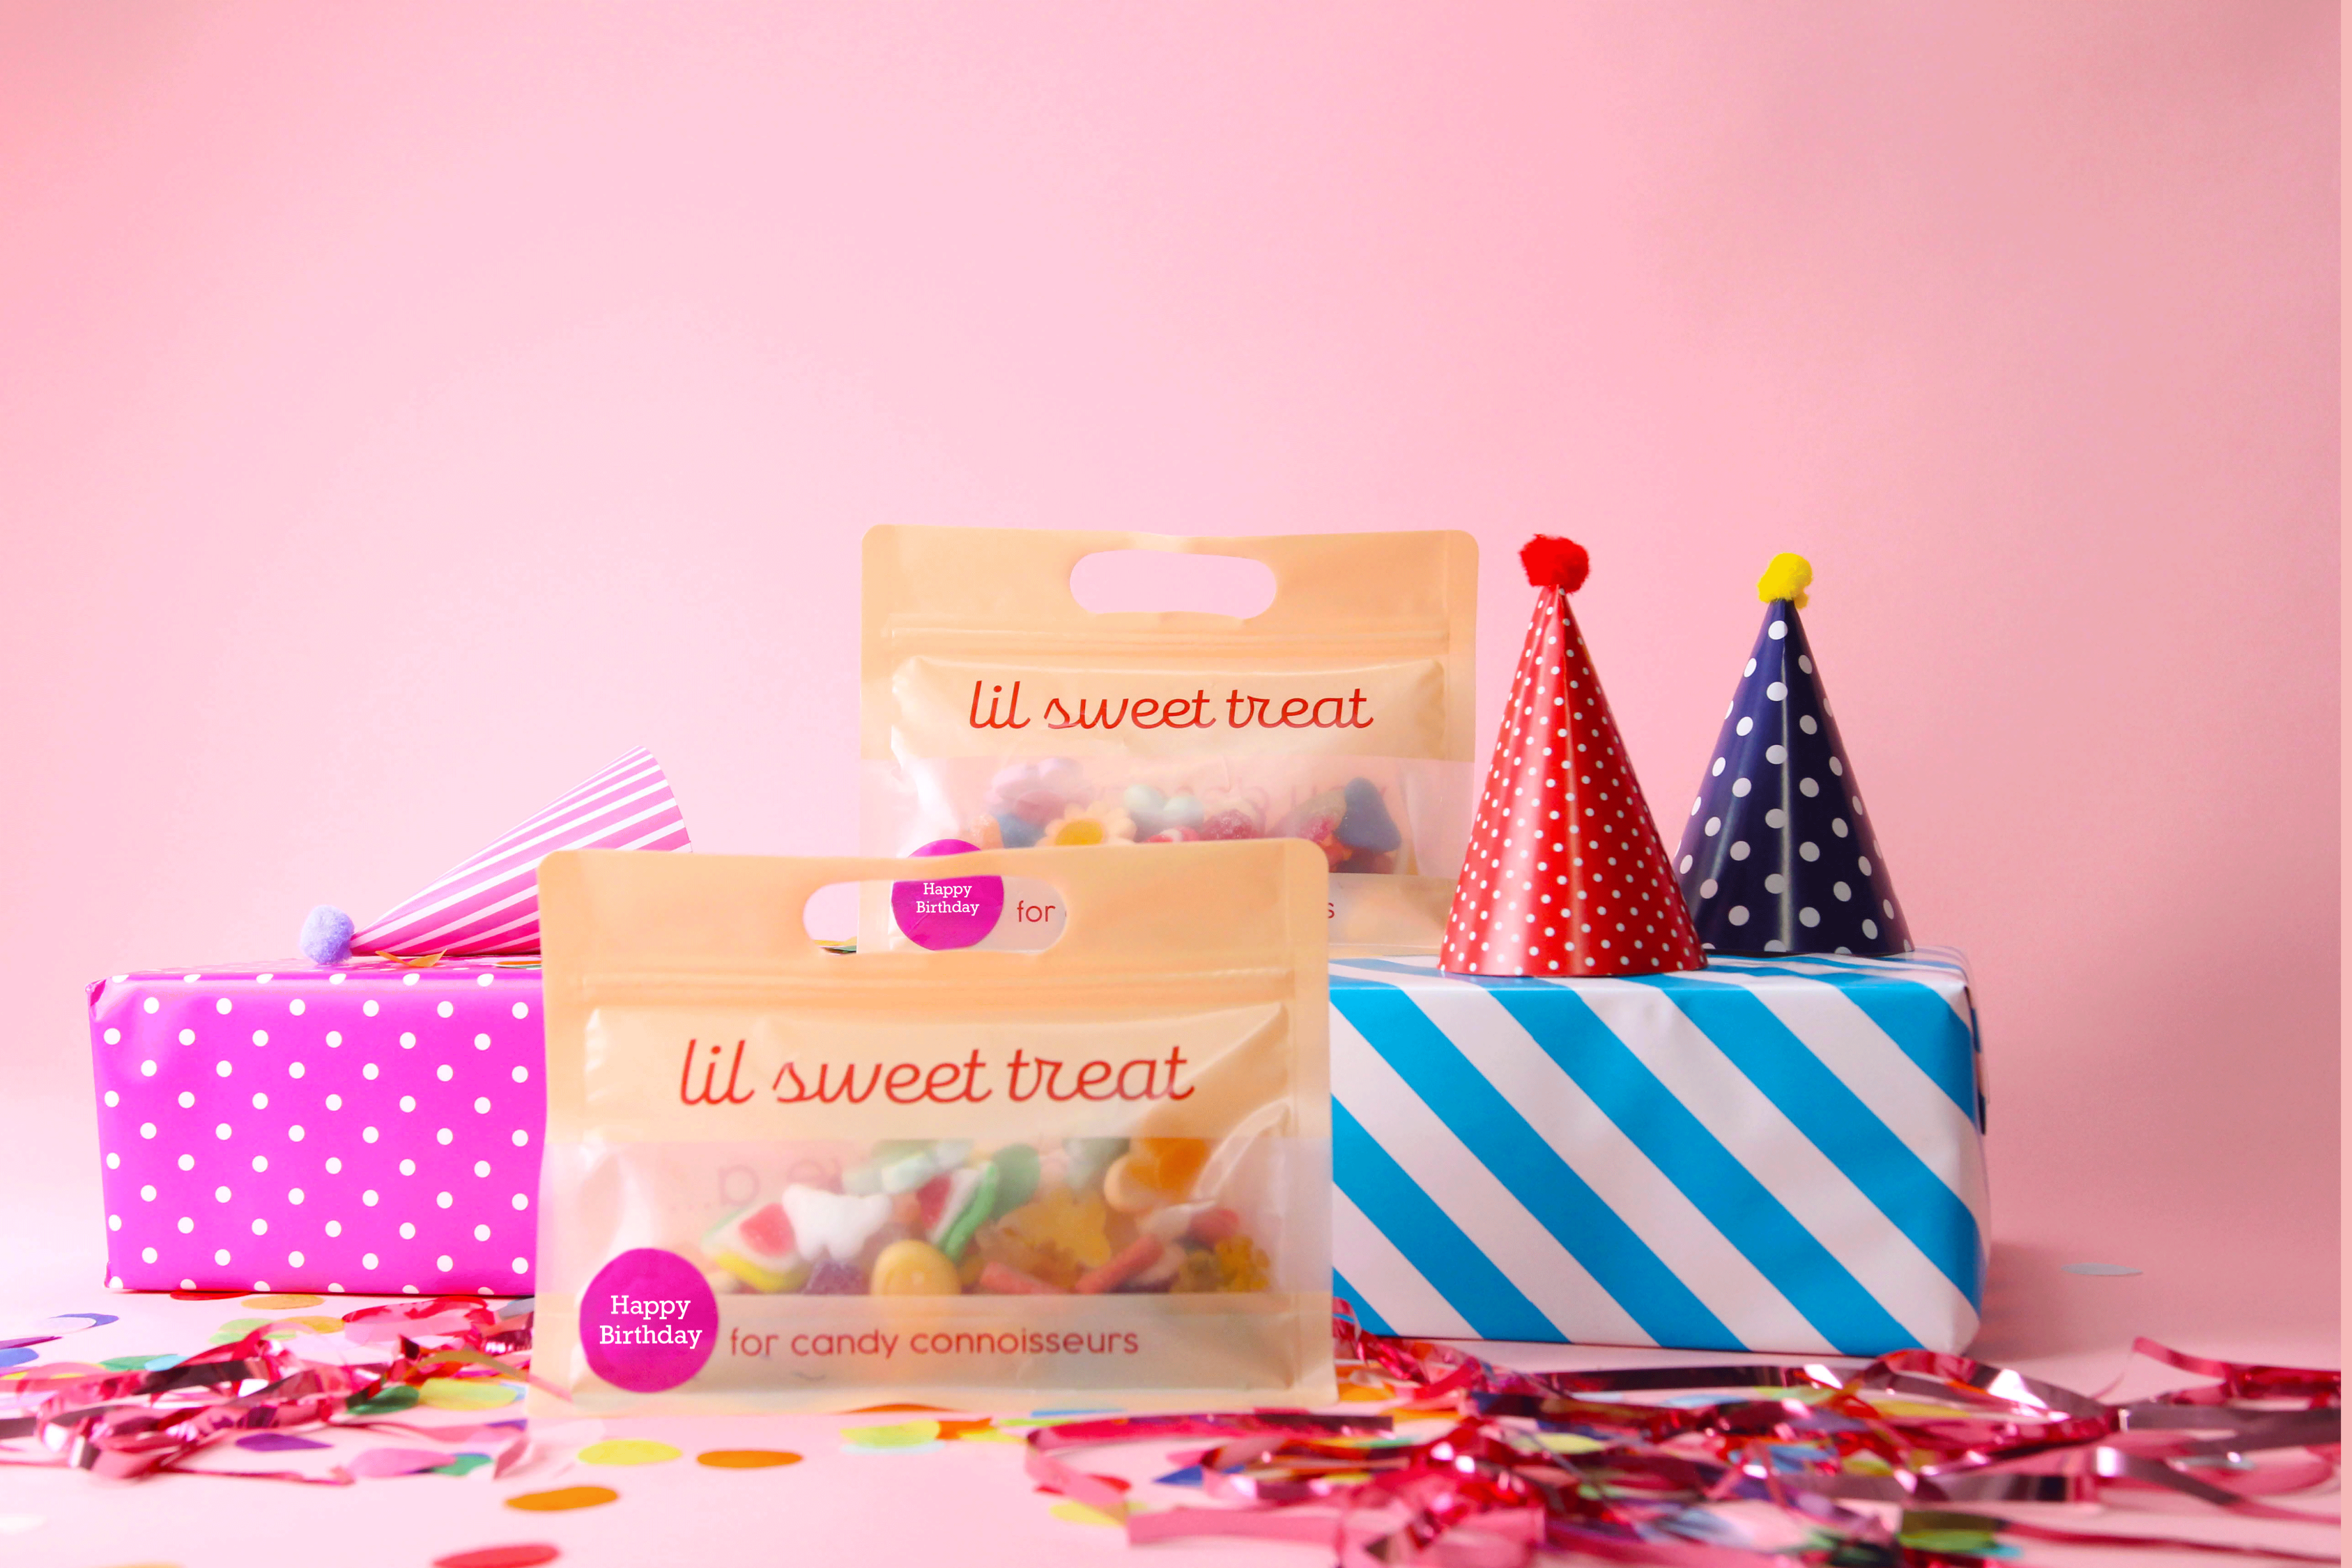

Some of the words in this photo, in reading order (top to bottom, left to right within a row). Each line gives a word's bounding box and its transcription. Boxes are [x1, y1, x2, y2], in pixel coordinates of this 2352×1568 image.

[969, 679, 1031, 730] lil
[1043, 689, 1217, 730] sweet
[1224, 687, 1375, 730] treat
[923, 882, 973, 898] Happy
[916, 900, 980, 916] Birthday
[1016, 900, 1056, 923] for
[679, 1038, 755, 1106] lil
[771, 1048, 994, 1106] sweet
[1006, 1045, 1196, 1103] treat
[610, 1295, 691, 1321] Happy
[599, 1324, 703, 1350] Birthday
[729, 1327, 779, 1357] for
[790, 1329, 899, 1360] candy
[909, 1328, 1140, 1355] connoisseurs
